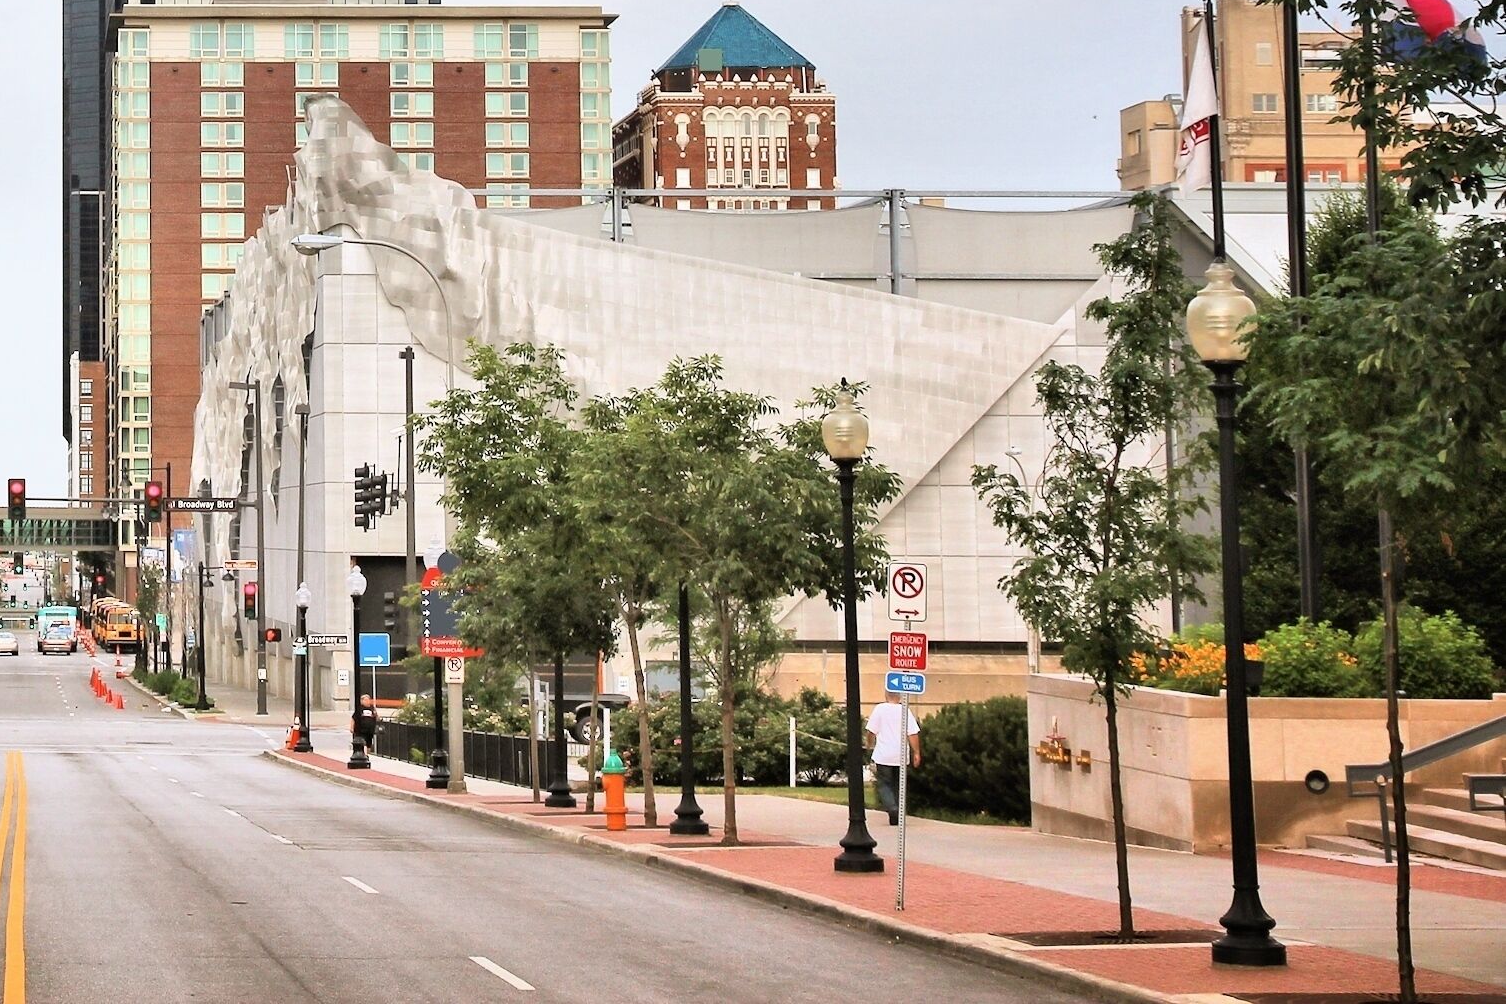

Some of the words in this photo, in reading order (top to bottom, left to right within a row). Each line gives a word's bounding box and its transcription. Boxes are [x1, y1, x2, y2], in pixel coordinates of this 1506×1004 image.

[178, 500, 214, 510] Broadway
[217, 500, 234, 509] Blvd
[308, 636, 337, 645] Broadway
[892, 635, 924, 645] EMERGENCY
[894, 645, 922, 657] SNOW
[895, 658, 918, 667] ROUTE
[901, 675, 917, 683] BUS
[902, 683, 921, 691] TURN
